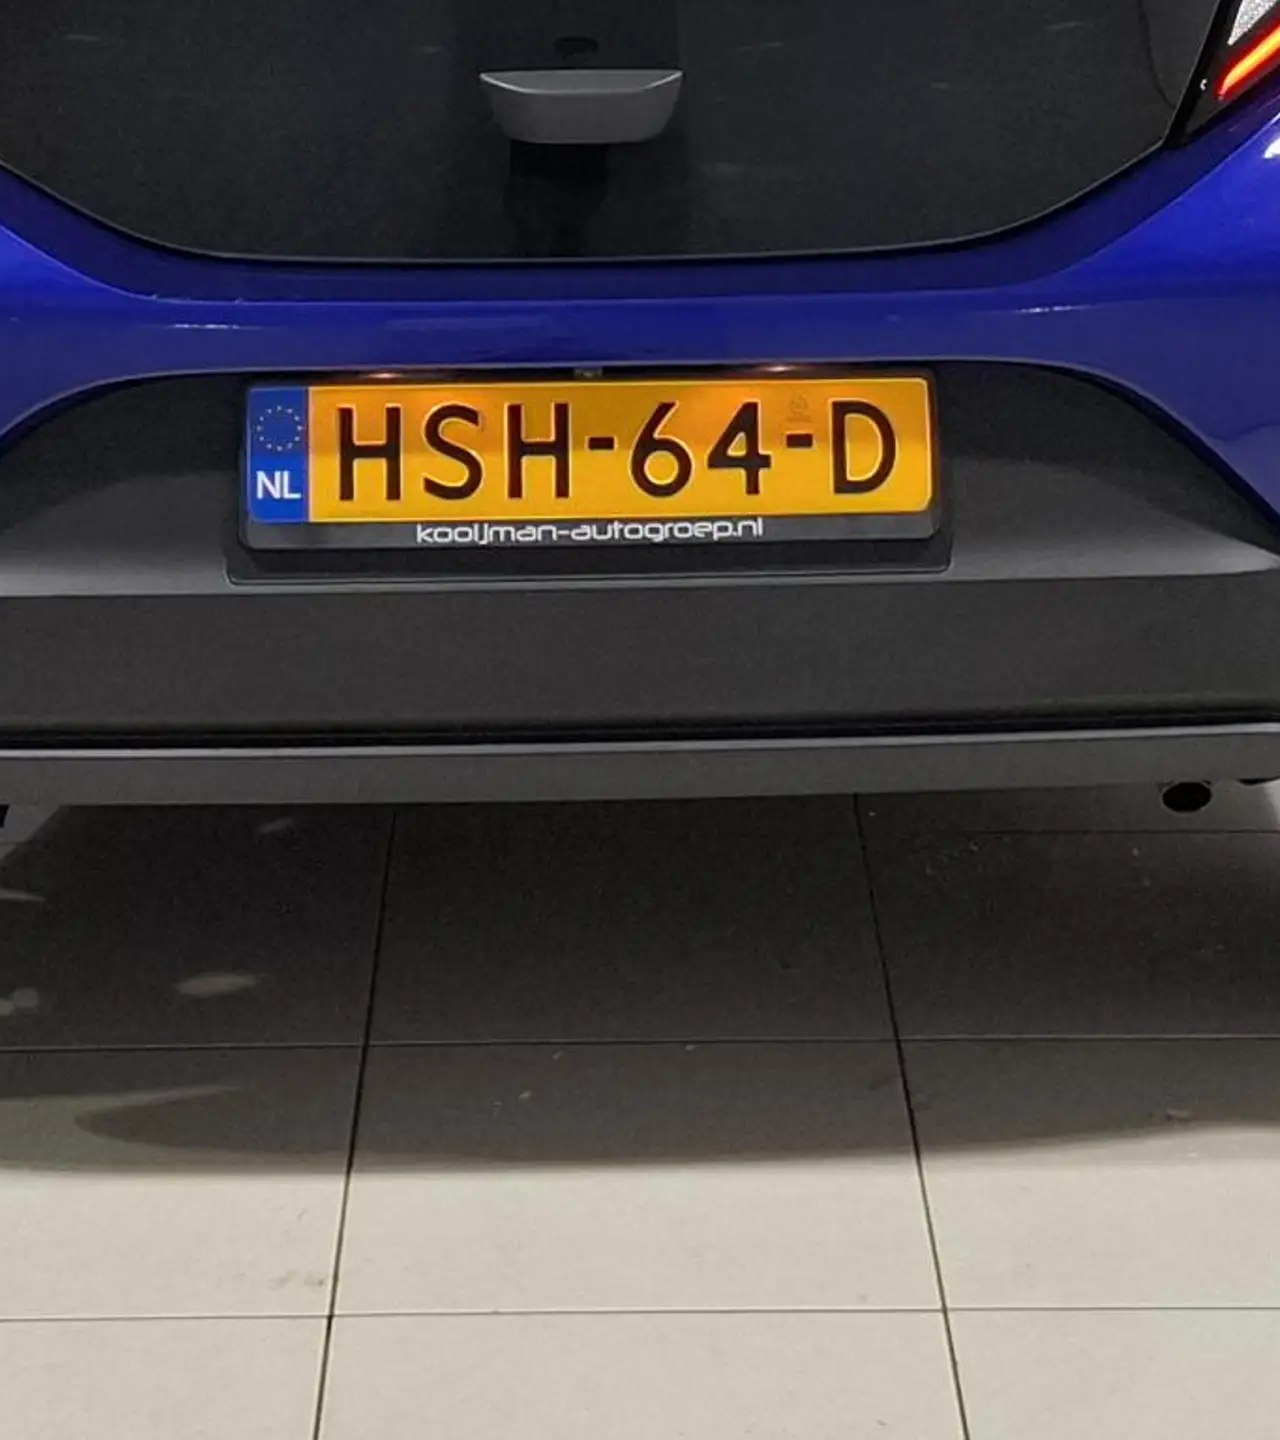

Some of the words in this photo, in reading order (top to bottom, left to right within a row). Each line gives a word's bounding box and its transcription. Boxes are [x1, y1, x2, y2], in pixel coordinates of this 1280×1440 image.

[337, 400, 897, 501] HSH-64-D
[256, 470, 302, 499] NL
[416, 517, 763, 545] kooijman-autogroep.nl
